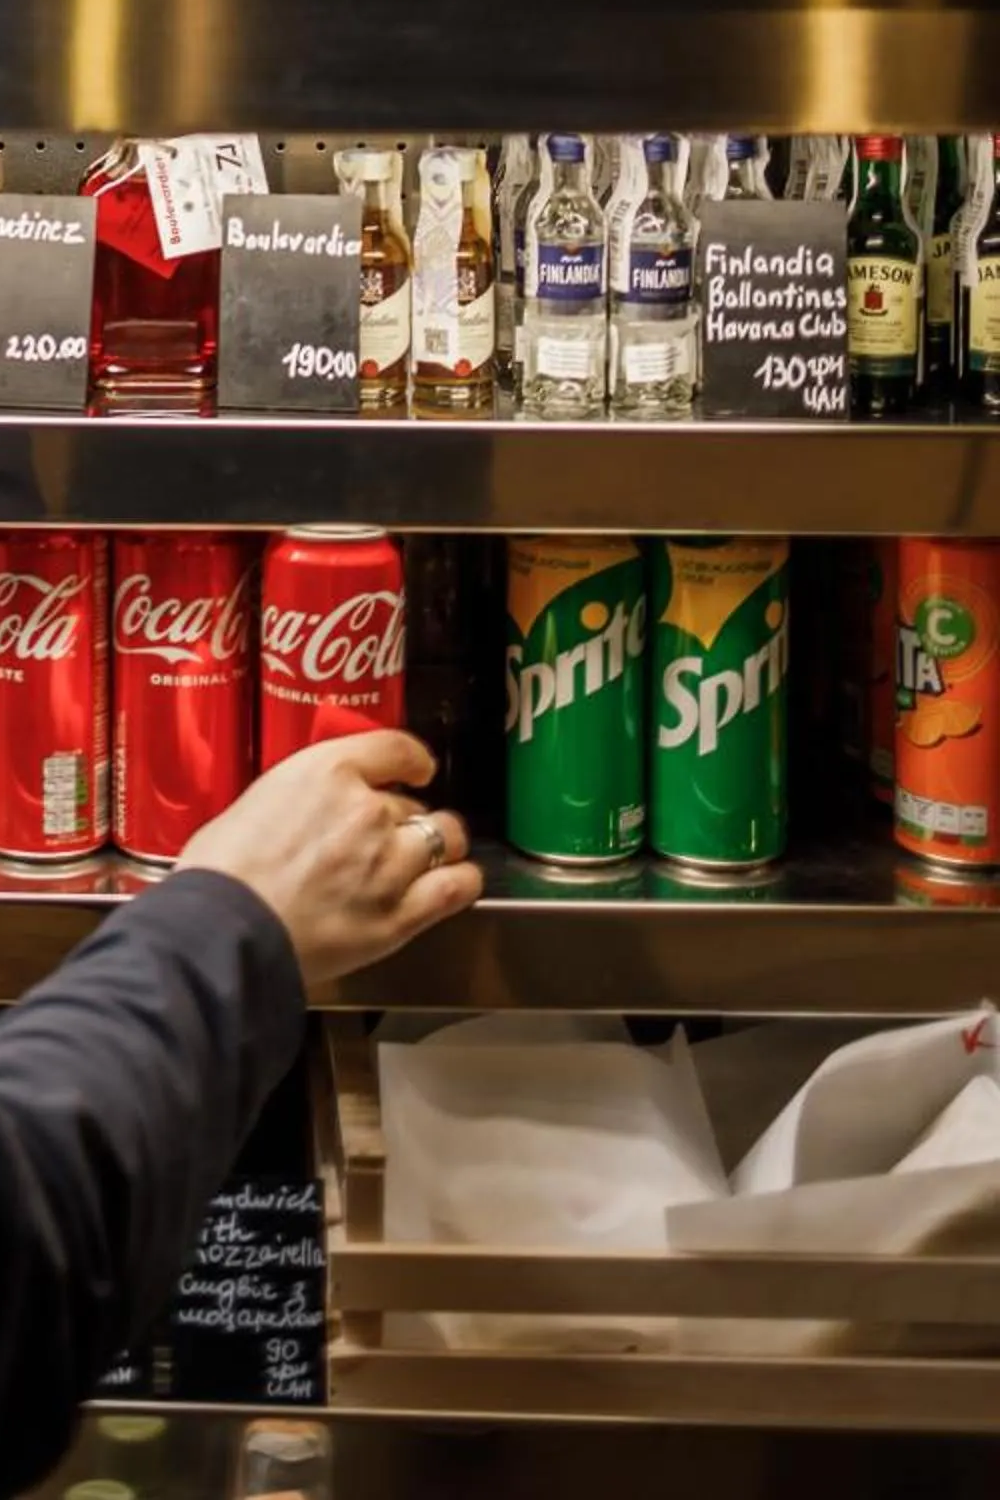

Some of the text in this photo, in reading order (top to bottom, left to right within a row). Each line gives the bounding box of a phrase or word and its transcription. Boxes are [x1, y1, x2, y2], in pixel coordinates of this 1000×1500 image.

[705, 243, 834, 277] Finlandia
[633, 268, 690, 290] FINLANDI
[847, 264, 913, 285] AMESON
[706, 312, 795, 342] Havana
[799, 310, 847, 337] Club
[753, 353, 806, 389] 130
[150, 672, 227, 688] ORIGINAL
[330, 691, 380, 706] TASTE
[201, 1211, 255, 1243] ith
[197, 1236, 327, 1269] ozzarella
[266, 1338, 299, 1362] 90
